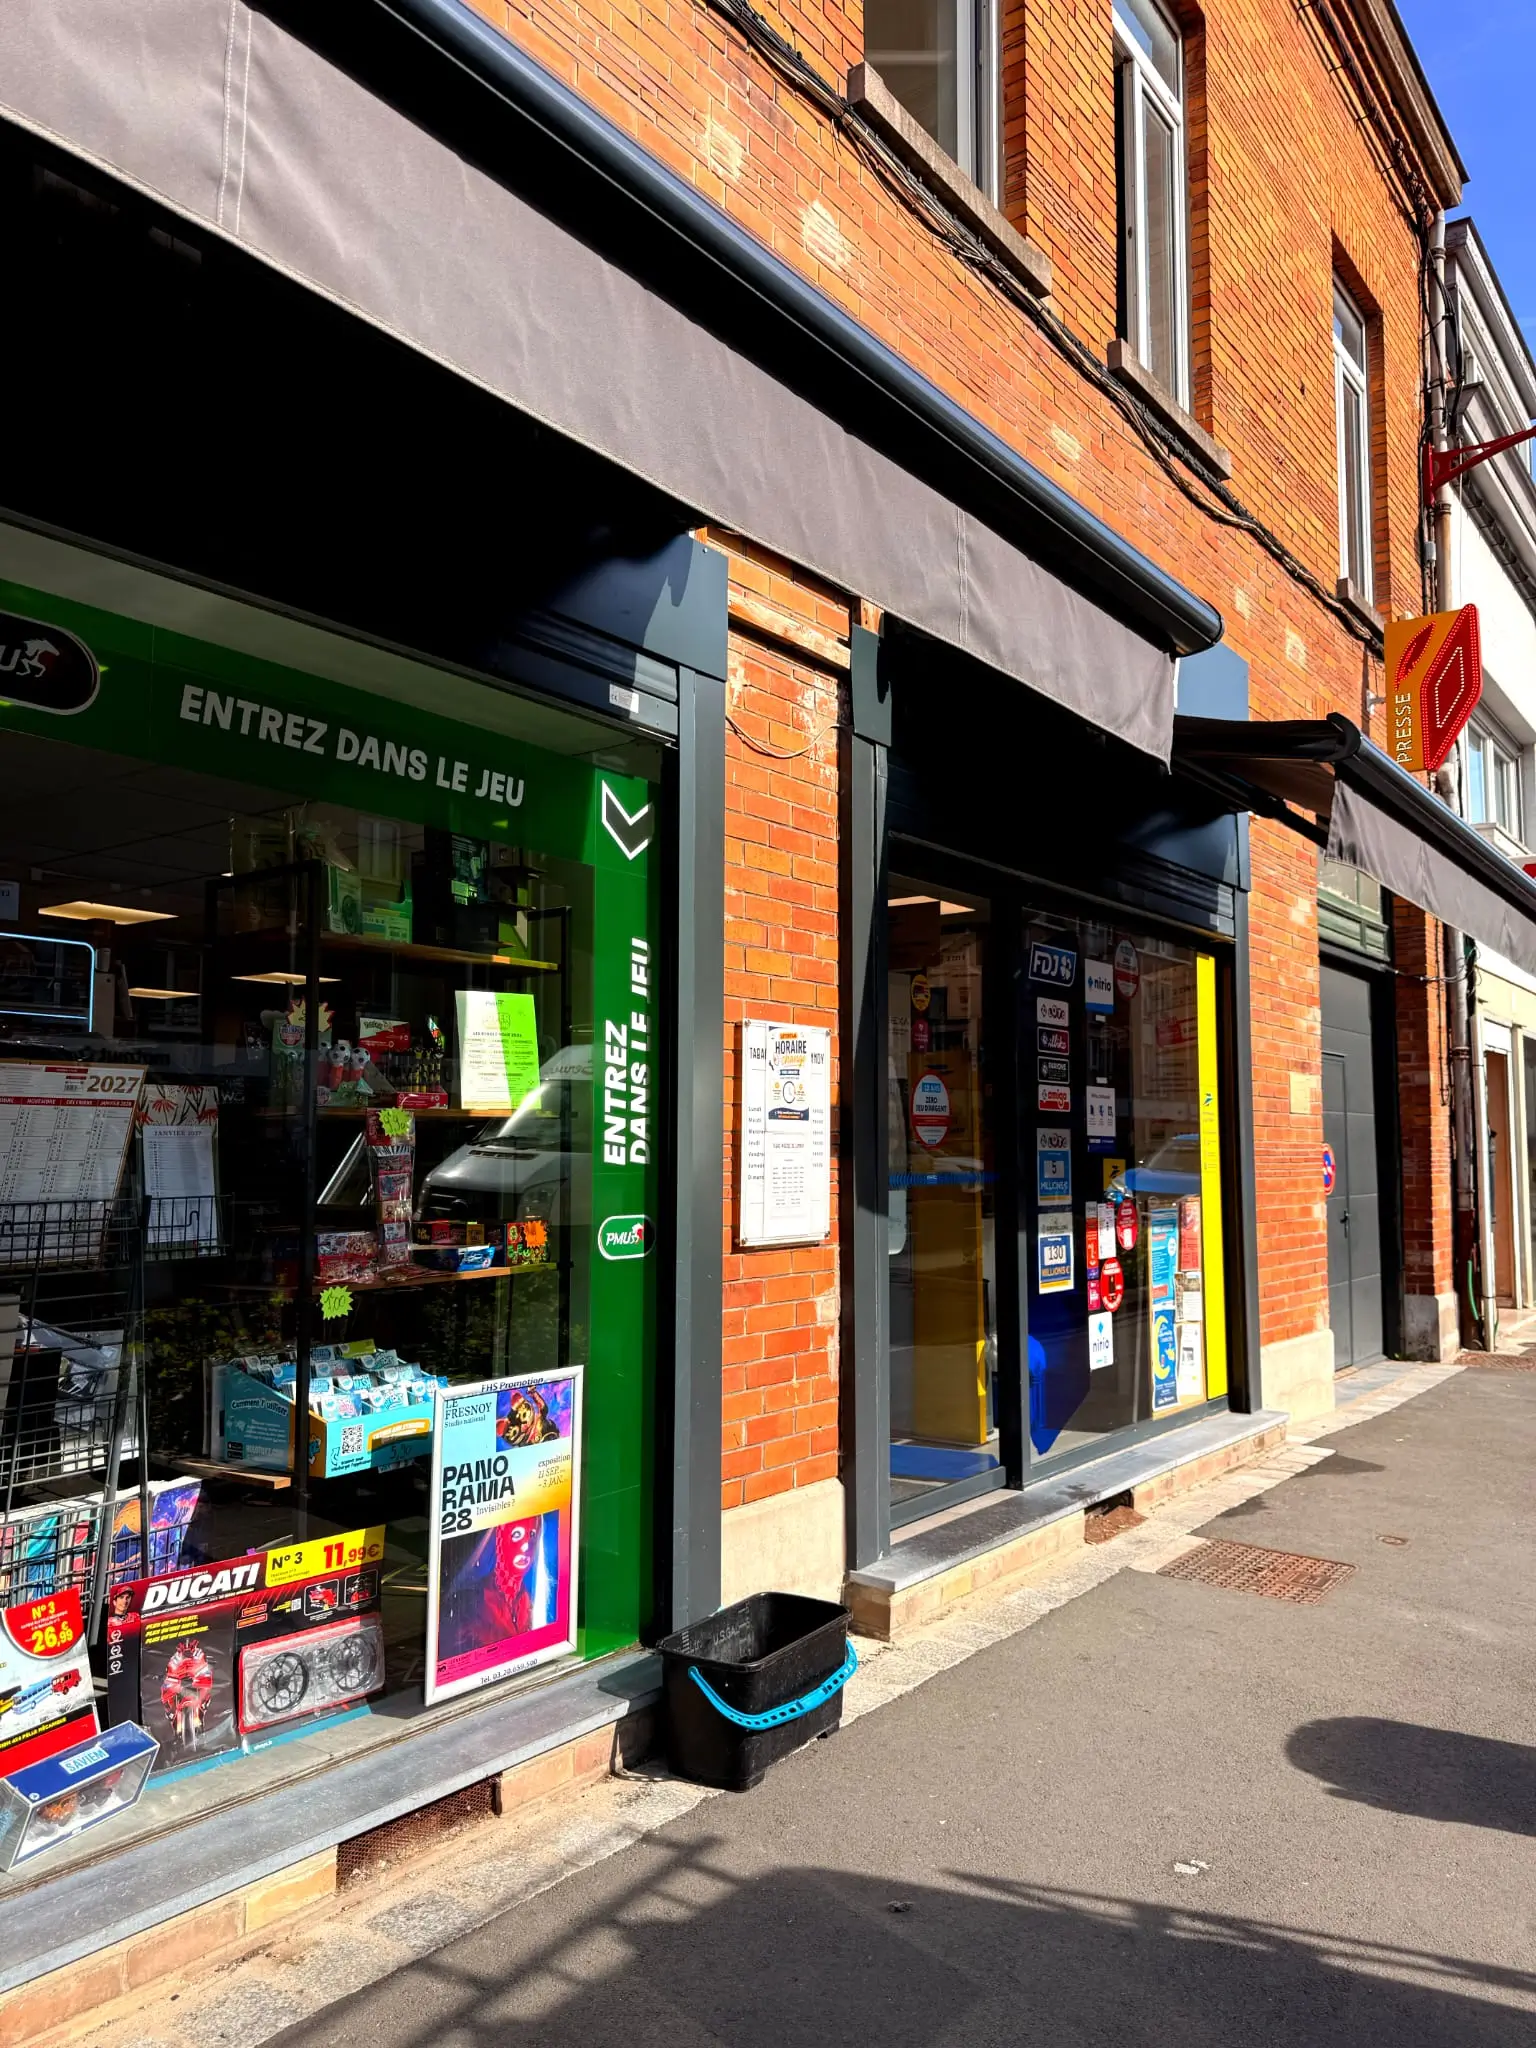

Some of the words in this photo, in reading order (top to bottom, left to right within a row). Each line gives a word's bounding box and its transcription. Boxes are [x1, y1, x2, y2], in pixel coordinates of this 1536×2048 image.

[1395, 692, 1412, 763] PRESSE
[180, 684, 328, 755] ENTREZ
[335, 728, 428, 781] DANS
[436, 757, 469, 792] LE
[475, 769, 525, 807] JEU
[631, 936, 651, 1004] JEU
[1033, 950, 1059, 977] FDJ
[1094, 976, 1111, 992] nirio
[631, 1011, 651, 1052] LE
[776, 1040, 807, 1054] HORAIRE
[87, 1075, 140, 1093] 2027
[604, 1019, 627, 1165] ENTREZ
[630, 1062, 651, 1164] DANS
[1052, 1160, 1056, 1174] 5
[606, 1232, 632, 1245] PMU
[1049, 1246, 1063, 1260] 130
[1093, 1337, 1109, 1352] nirio
[481, 1382, 498, 1392] FHS
[499, 1376, 544, 1390] Promotion
[445, 1399, 458, 1409] LE
[445, 1402, 493, 1420] FRESNOY
[444, 1419, 462, 1428] Studio
[463, 1415, 486, 1425] national
[538, 1454, 571, 1468] exposition
[442, 1455, 509, 1489] PANO
[442, 1475, 515, 1511] RAMA
[441, 1508, 472, 1535] 28
[294, 1551, 303, 1564] 3
[141, 1562, 260, 1612] DUCATI
[48, 1601, 55, 1614] 3
[65, 1749, 106, 1772] SAVIEM
